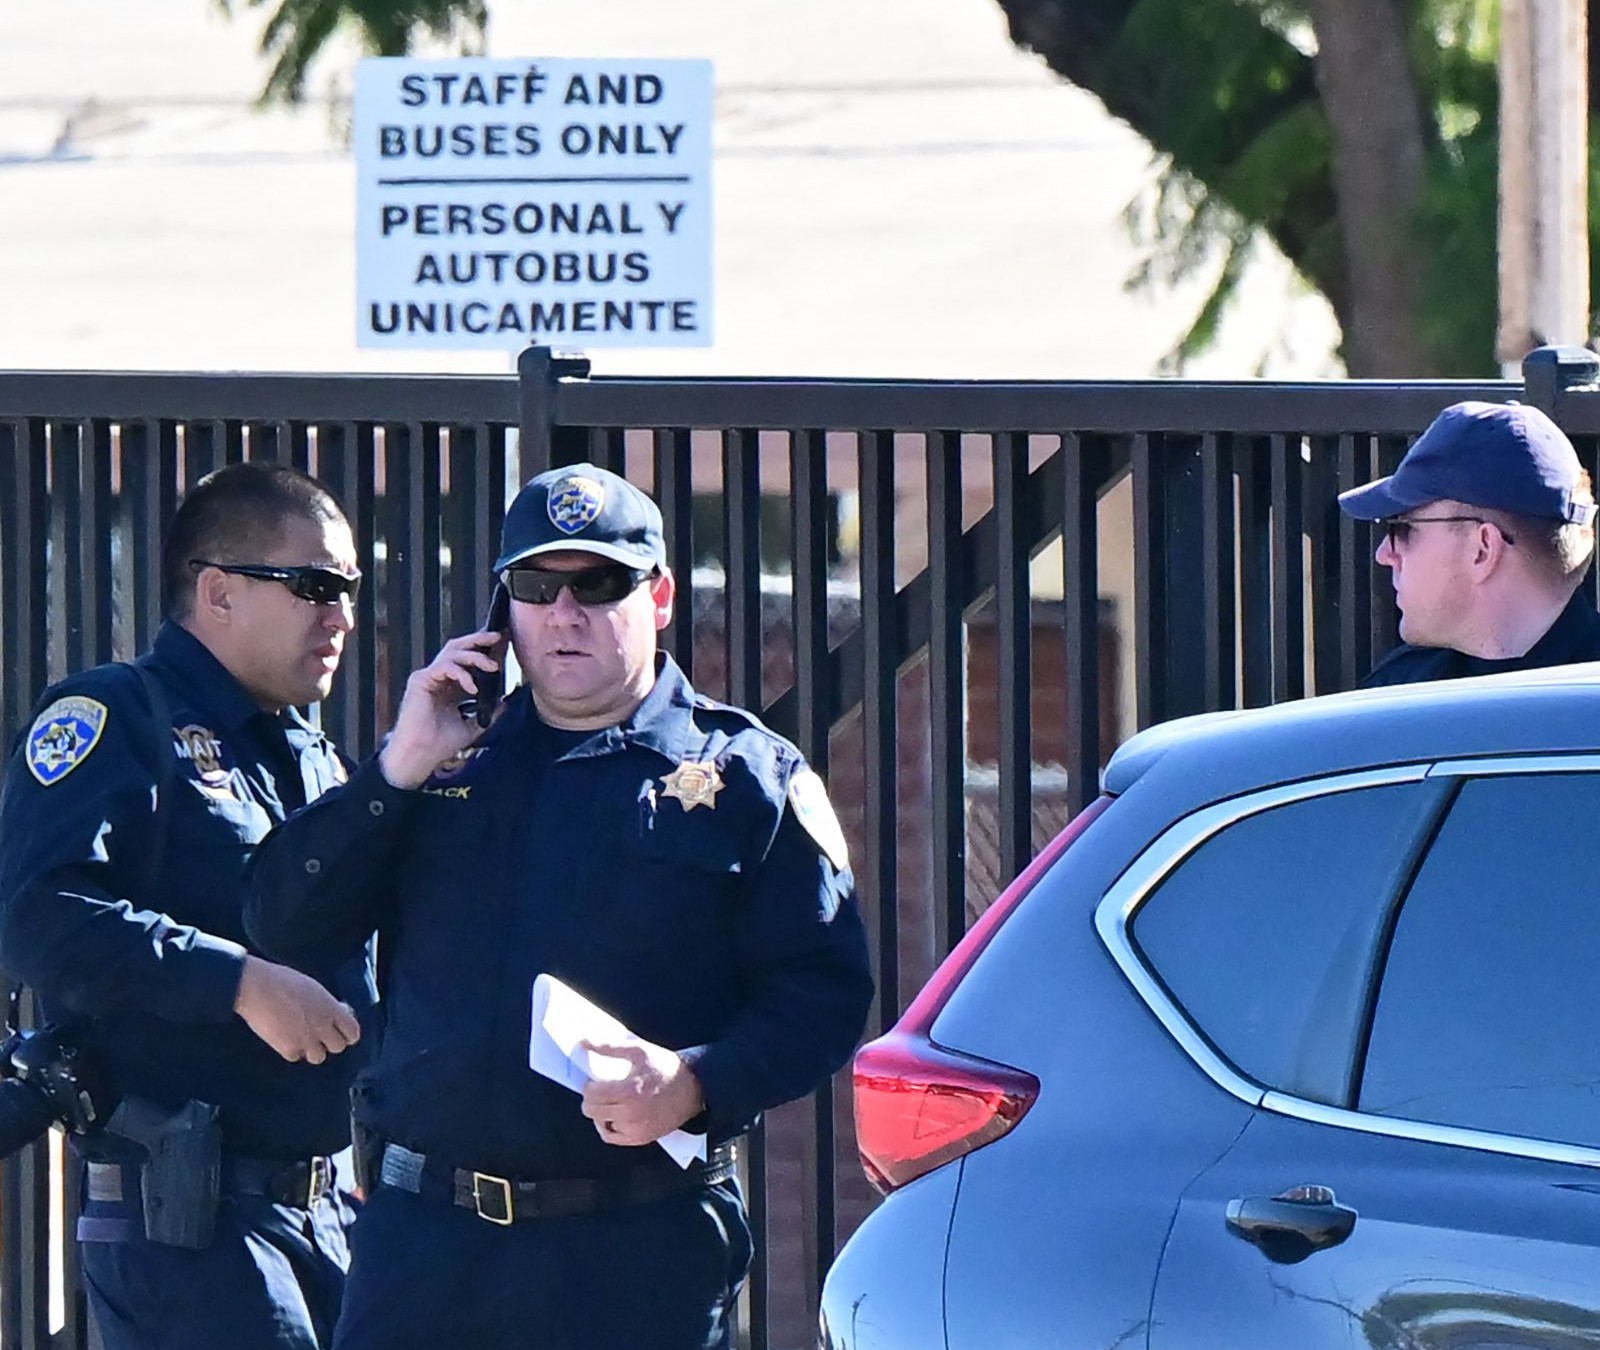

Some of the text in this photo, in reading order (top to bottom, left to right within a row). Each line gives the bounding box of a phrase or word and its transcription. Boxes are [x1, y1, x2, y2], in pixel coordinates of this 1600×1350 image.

[402, 73, 662, 106] STAFF AND
[381, 125, 683, 157] BUSES ONLY
[383, 203, 683, 235] PERSONAL Y
[416, 253, 649, 283] AUTOBUS
[372, 301, 696, 333] UNICAMENTE
[173, 739, 222, 758] MAIT
